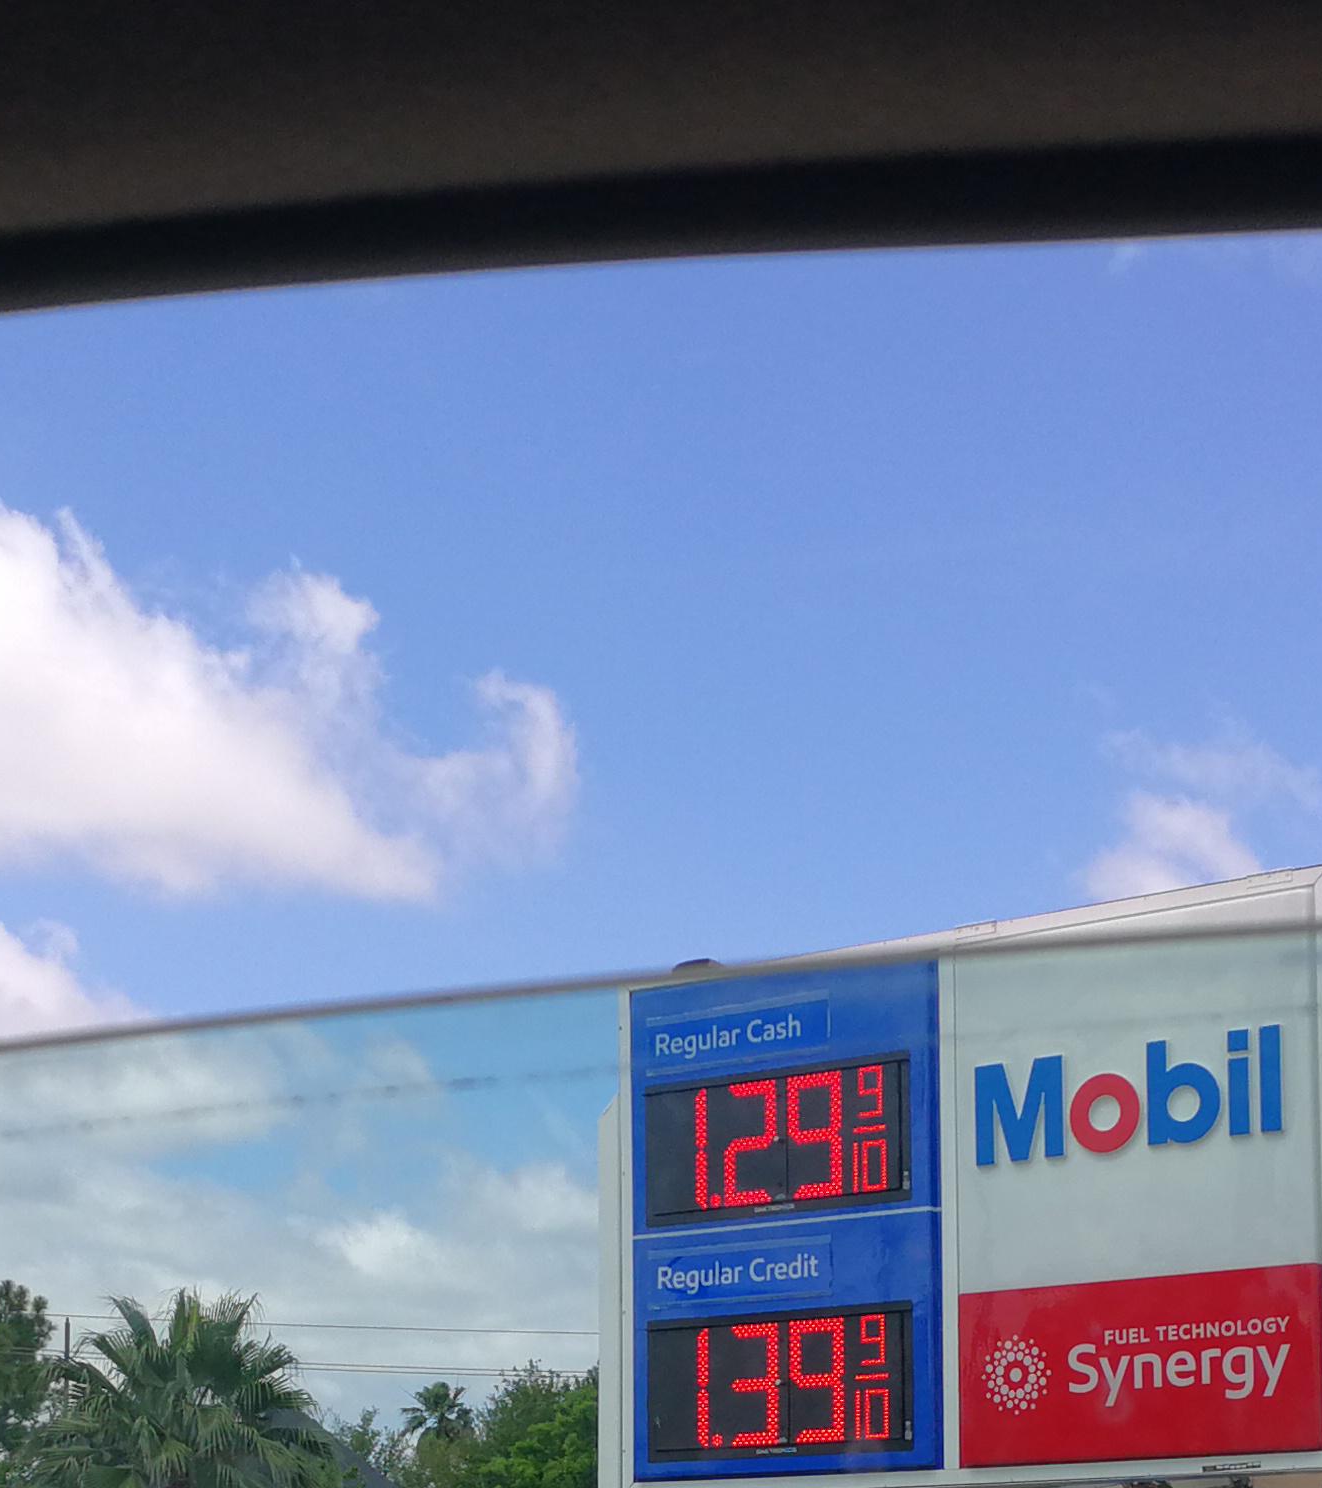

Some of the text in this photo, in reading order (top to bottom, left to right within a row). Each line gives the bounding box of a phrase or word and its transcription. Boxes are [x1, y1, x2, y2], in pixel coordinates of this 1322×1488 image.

[655, 1013, 802, 1059] Regular Cash
[974, 1024, 1282, 1167] Mobil
[657, 1253, 819, 1294] Regular Credit
[1104, 1316, 1290, 1346] FUEL TECHNOLOGY
[1067, 1343, 1291, 1407] Synergy
